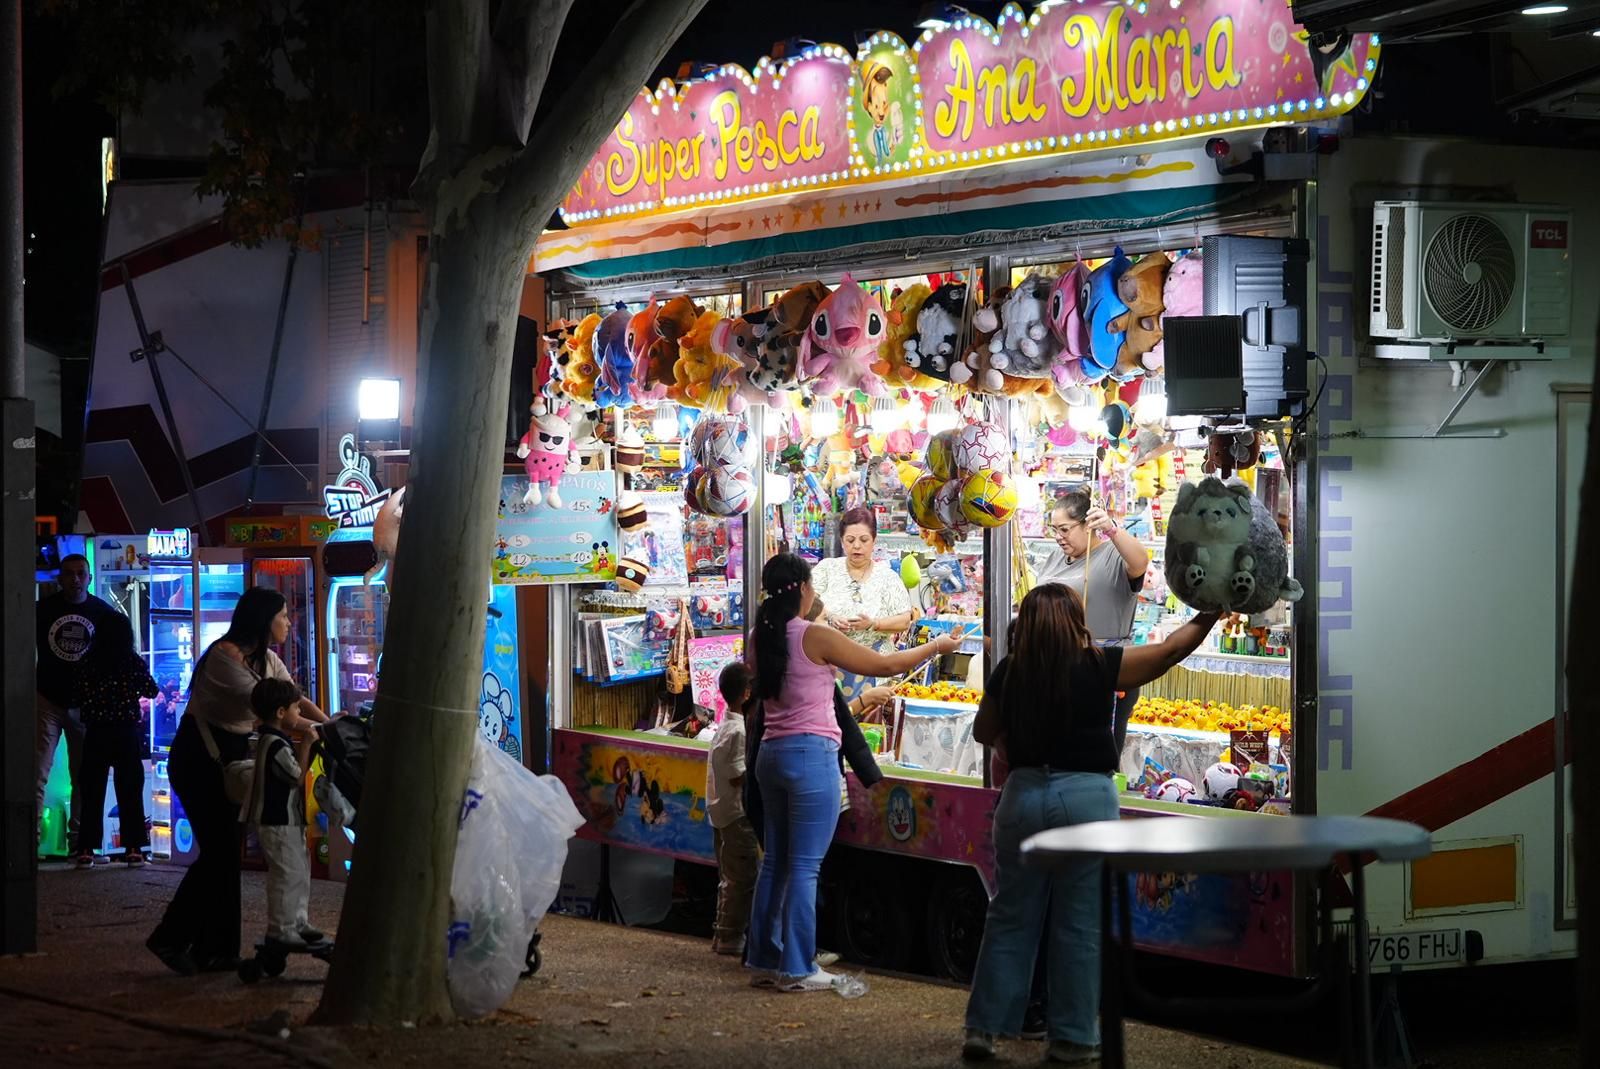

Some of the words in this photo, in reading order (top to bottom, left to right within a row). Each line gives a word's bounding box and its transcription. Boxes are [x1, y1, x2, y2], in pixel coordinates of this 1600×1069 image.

[935, 38, 1046, 141] Ana
[1062, 5, 1242, 118] Maria
[606, 113, 704, 199] Super
[710, 89, 825, 180] Pesca
[1536, 229, 1564, 241] TCL
[327, 493, 363, 513] STOP
[1369, 936, 1410, 962] 766
[1420, 932, 1459, 959] FHJ
